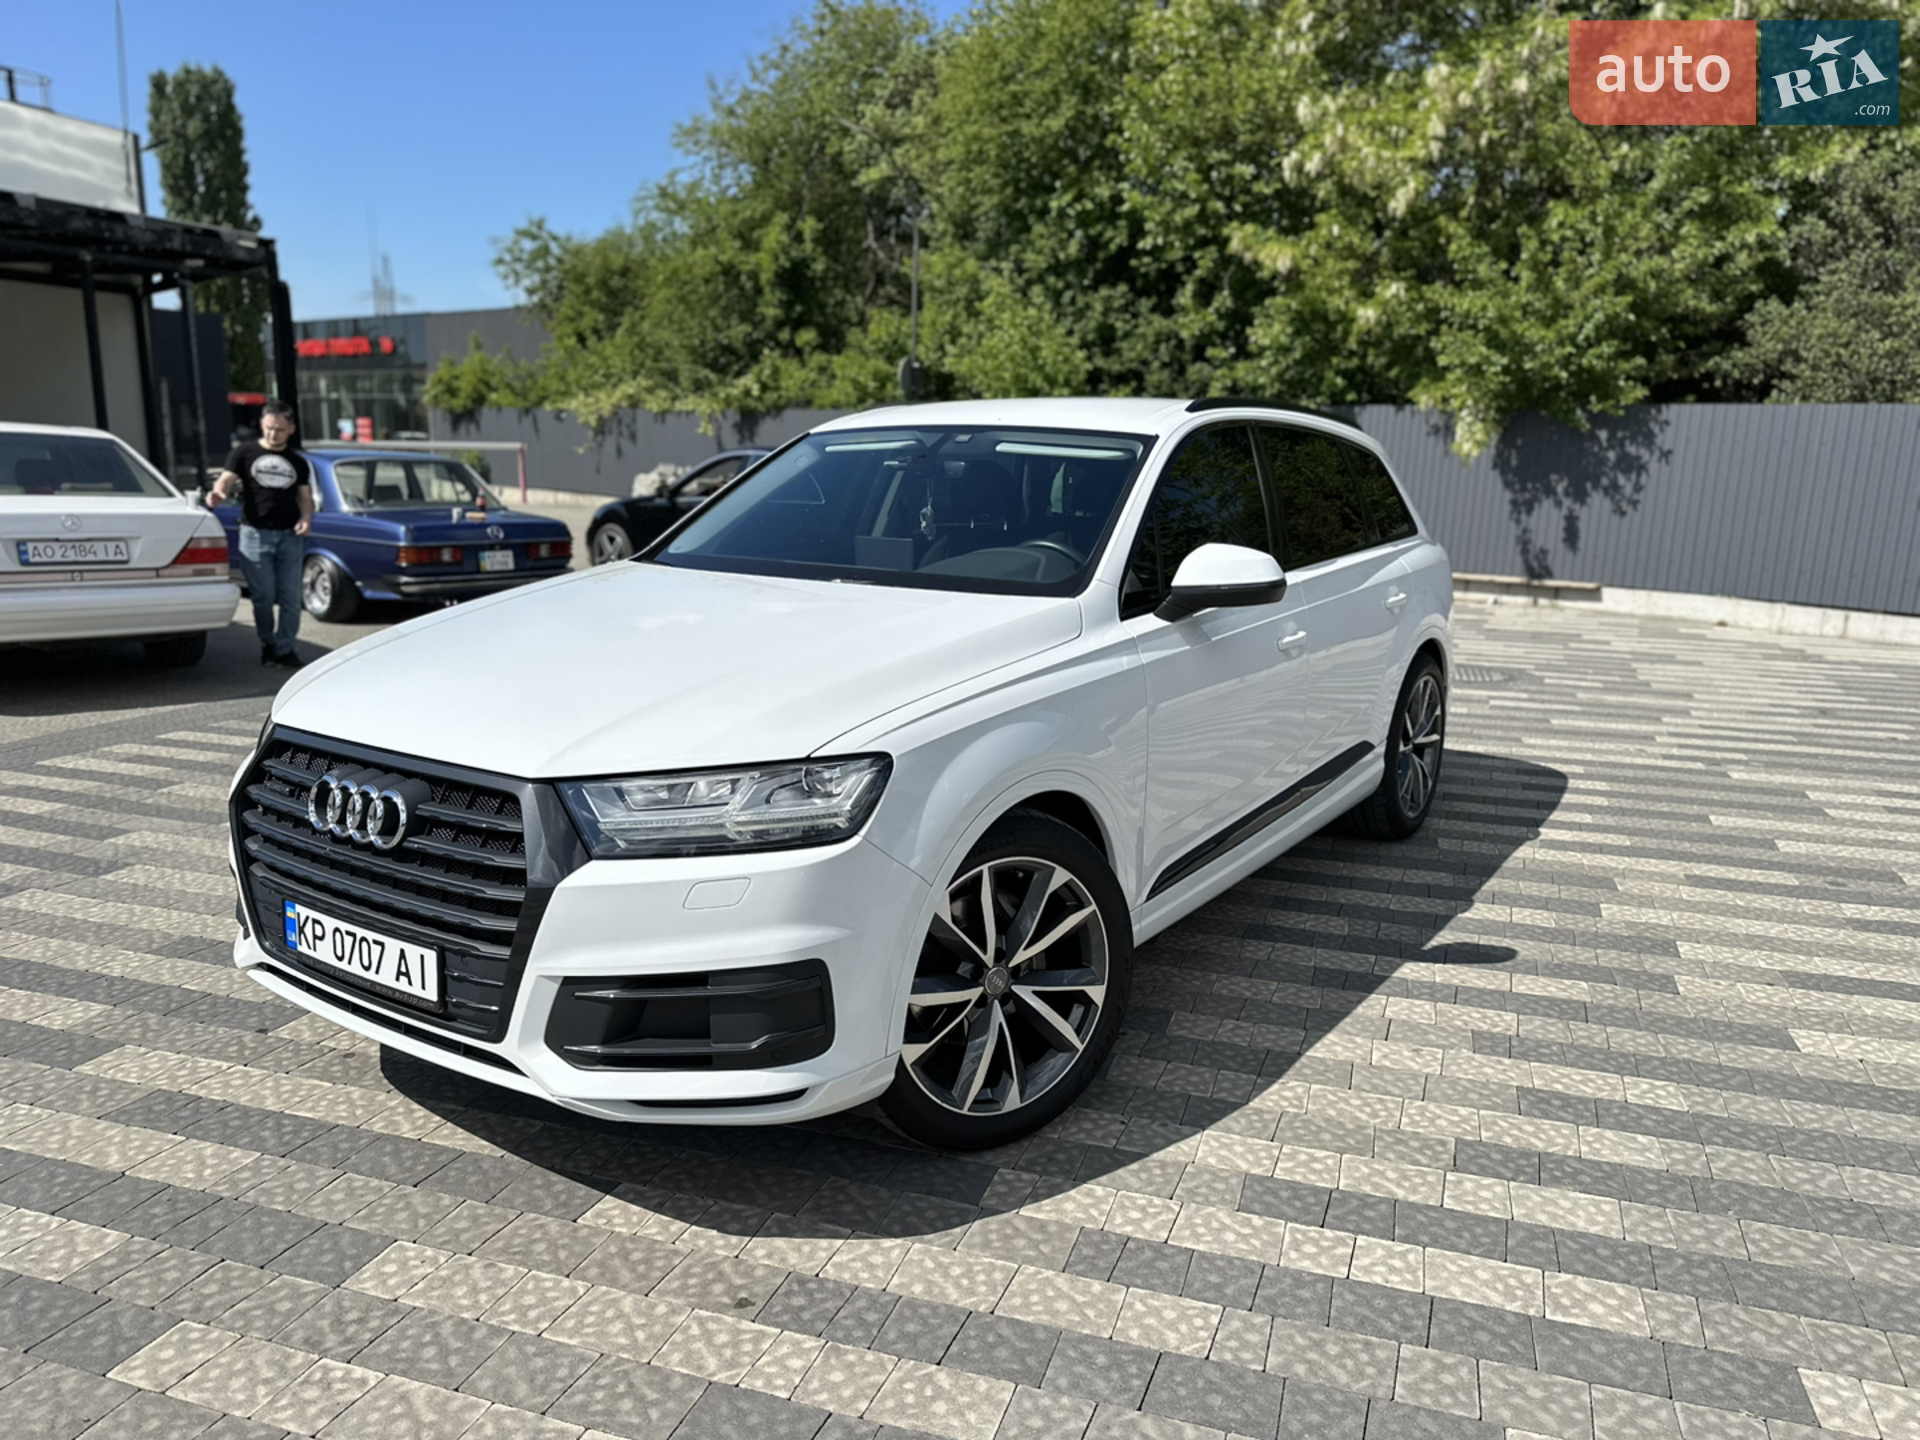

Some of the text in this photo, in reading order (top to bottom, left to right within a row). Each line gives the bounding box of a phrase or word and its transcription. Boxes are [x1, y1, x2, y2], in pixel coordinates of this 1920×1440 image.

[32, 544, 56, 560] AO
[59, 543, 98, 559] 2184
[296, 911, 326, 953] KP
[332, 926, 386, 976] 0707
